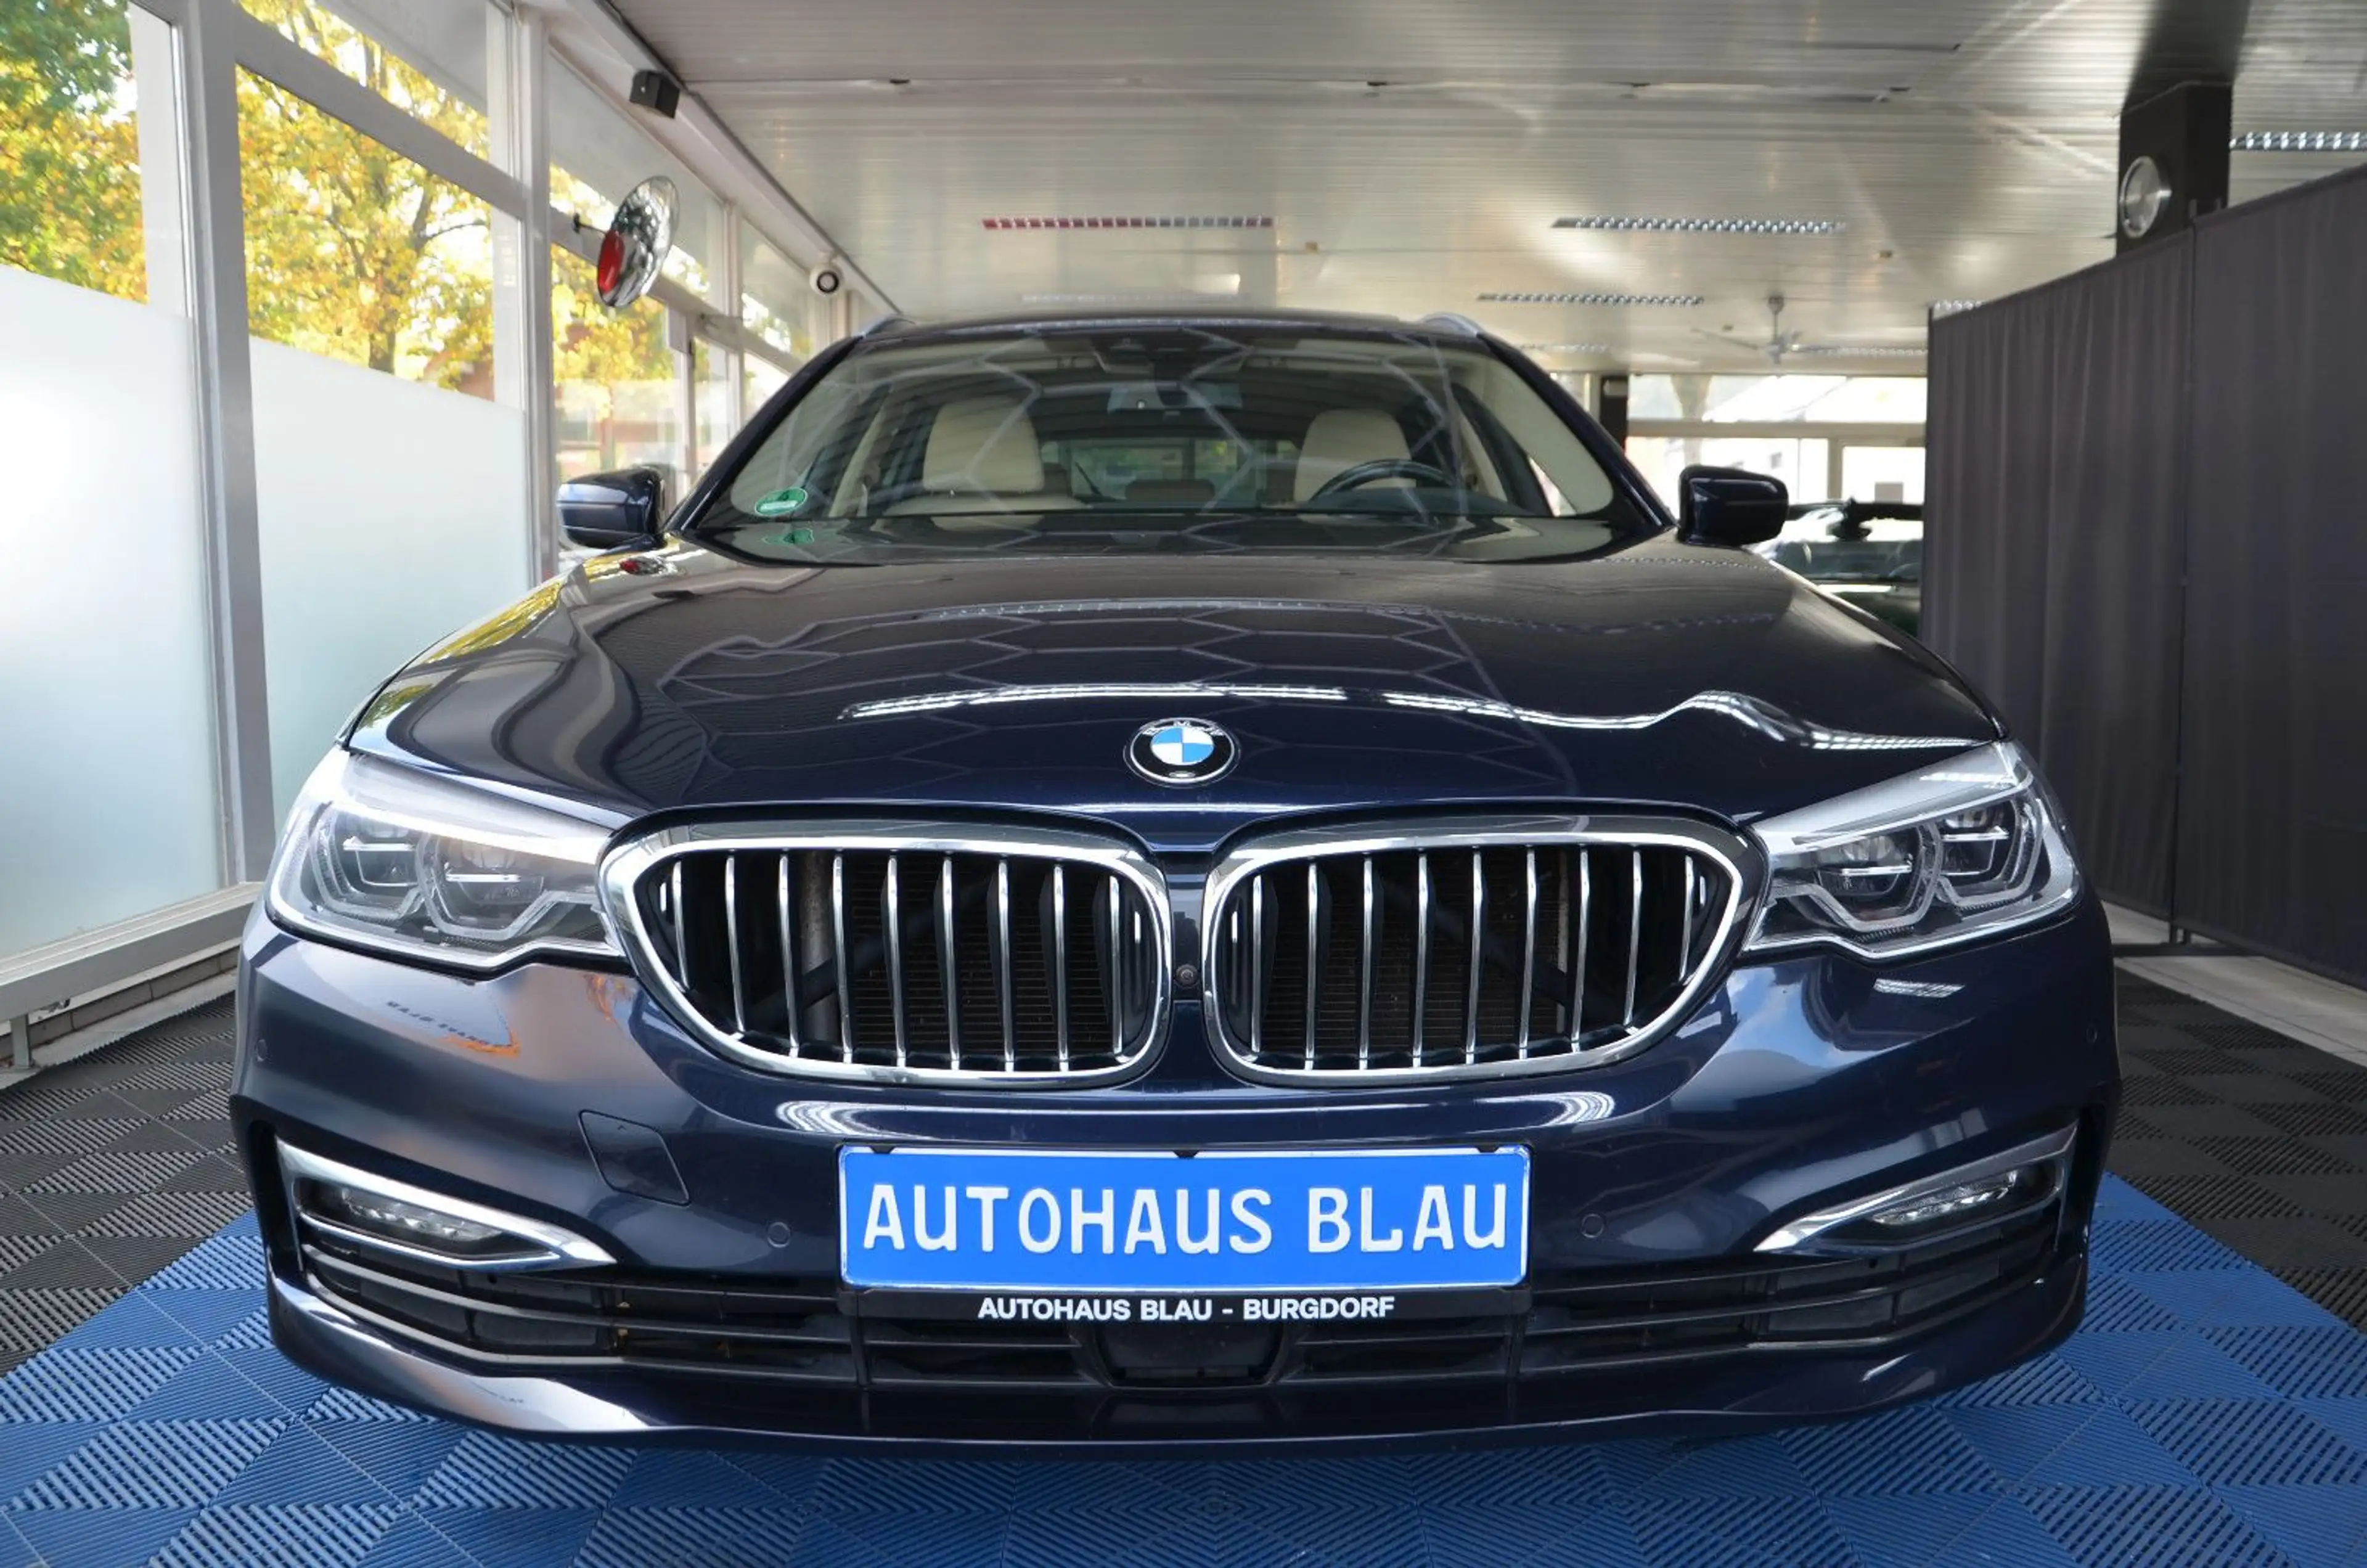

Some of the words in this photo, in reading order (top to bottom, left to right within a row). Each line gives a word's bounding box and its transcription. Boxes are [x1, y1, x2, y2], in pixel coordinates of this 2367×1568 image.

[864, 1184, 1272, 1254] AUTOHAUS
[1308, 1183, 1506, 1252] BLAU
[978, 1297, 1131, 1321] AUTOHAUS
[1140, 1299, 1212, 1321] BLAU
[1243, 1296, 1395, 1320] BURGDORF
